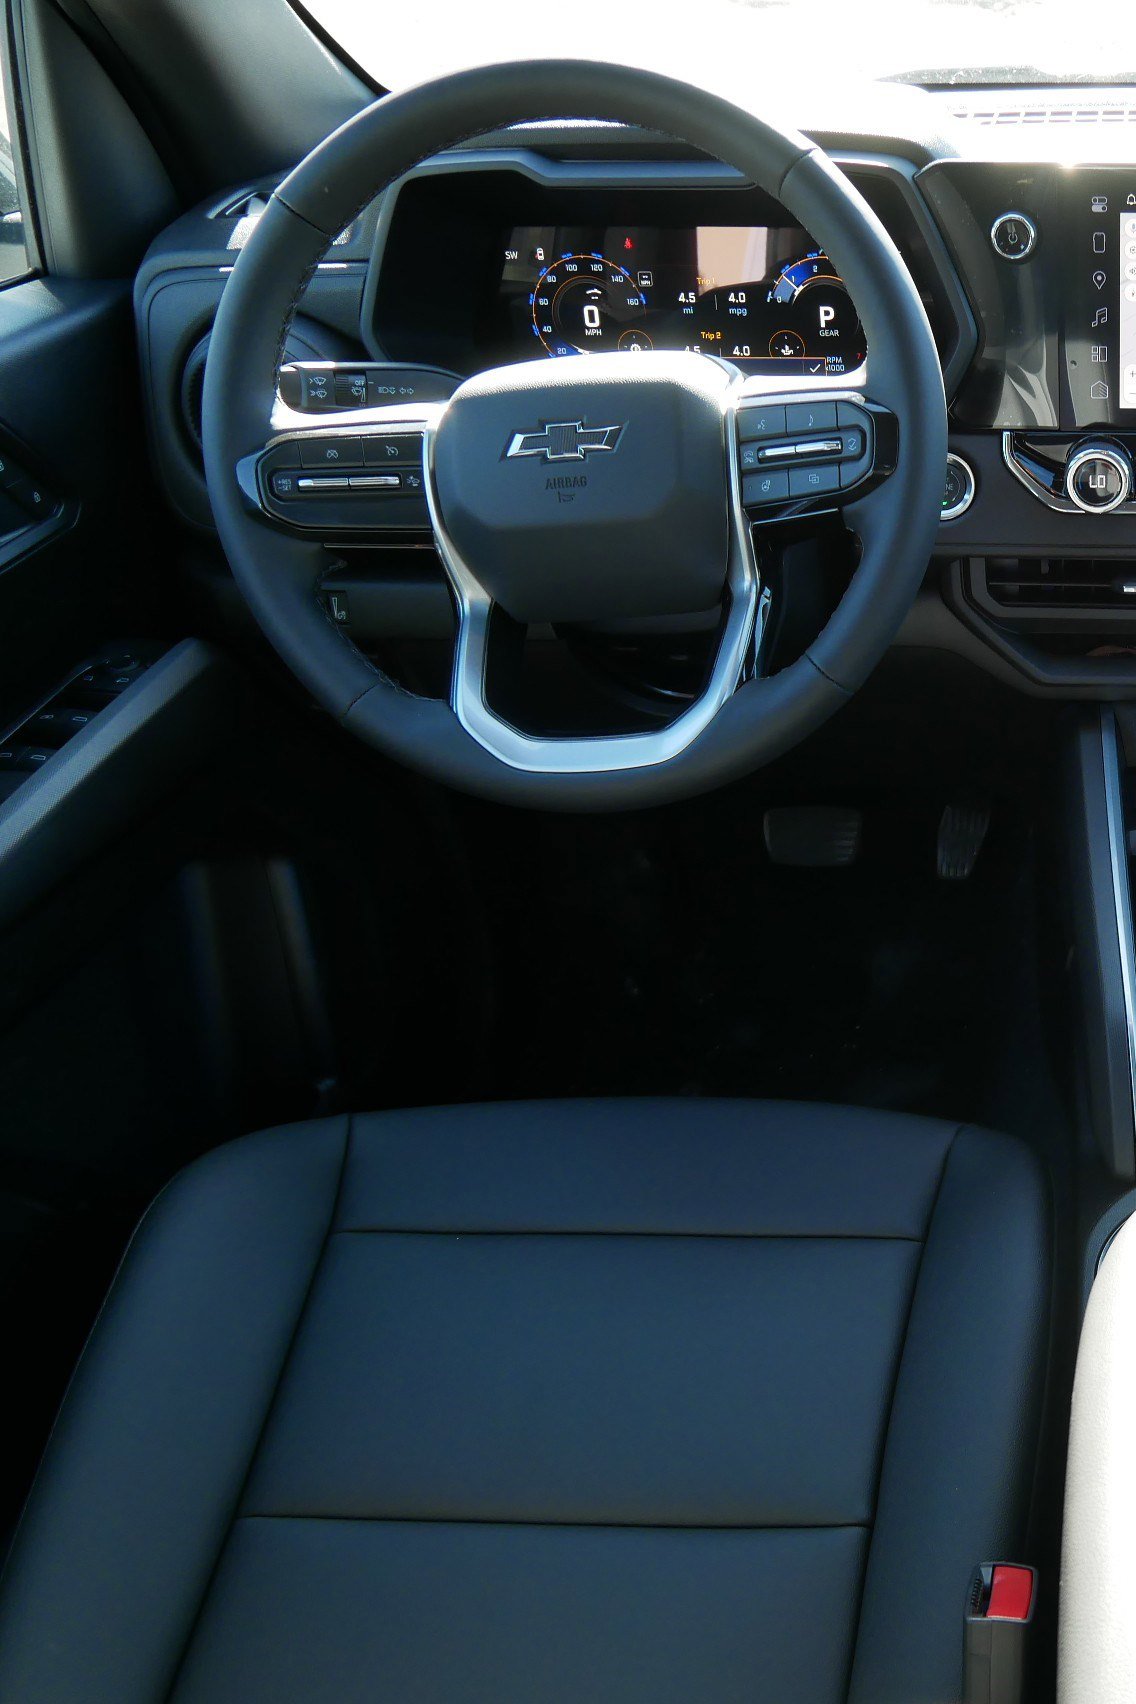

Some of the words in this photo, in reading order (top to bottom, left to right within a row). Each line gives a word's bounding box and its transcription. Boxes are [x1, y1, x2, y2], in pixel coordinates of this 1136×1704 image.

[505, 251, 518, 260] SW
[565, 264, 578, 272] 100
[590, 264, 603, 272] 120
[547, 275, 557, 283] 80
[611, 275, 624, 283] 140
[696, 277, 711, 285] Trip
[678, 292, 696, 303] 4.5
[728, 292, 746, 303] 4.0
[539, 298, 549, 306] 60
[626, 298, 639, 306] 160
[683, 306, 694, 314] mi
[729, 308, 747, 316] mpg
[583, 305, 600, 328] 0
[819, 306, 835, 328] P
[542, 325, 552, 333] 40
[819, 329, 840, 337] GEAR
[700, 331, 715, 341] Trip
[716, 331, 722, 339] 2
[557, 347, 567, 355] 20
[733, 345, 750, 356] 4.0
[826, 356, 842, 364] RPM
[545, 475, 588, 490] AIRBAG
[1089, 475, 1106, 488] LO
